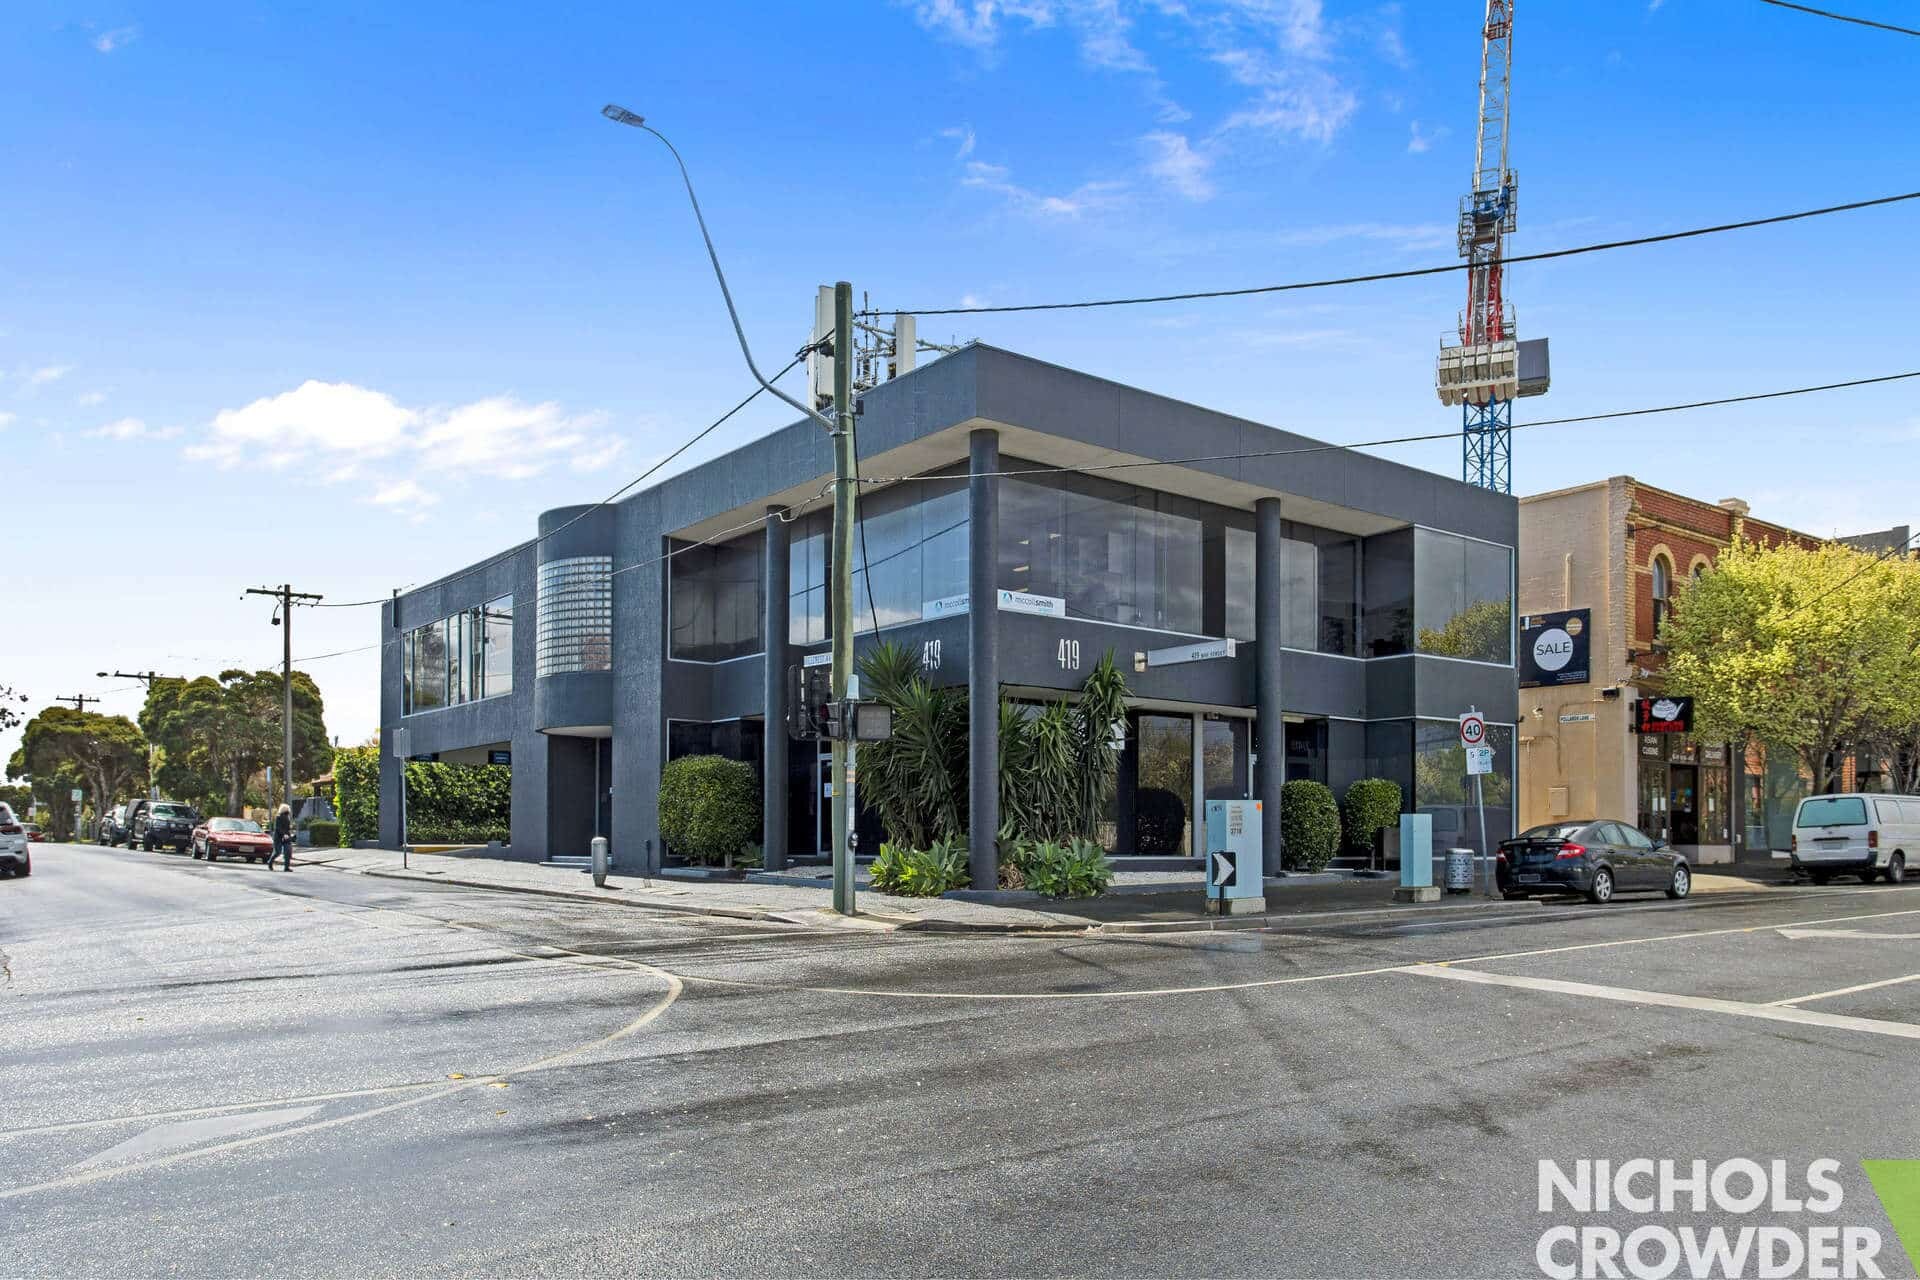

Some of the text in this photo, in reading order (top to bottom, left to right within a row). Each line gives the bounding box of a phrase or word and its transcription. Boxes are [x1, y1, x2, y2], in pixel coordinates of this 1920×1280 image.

[922, 639, 941, 671] 419
[1057, 638, 1080, 670] 419
[1536, 641, 1572, 656] SALE
[1465, 724, 1481, 736] 40
